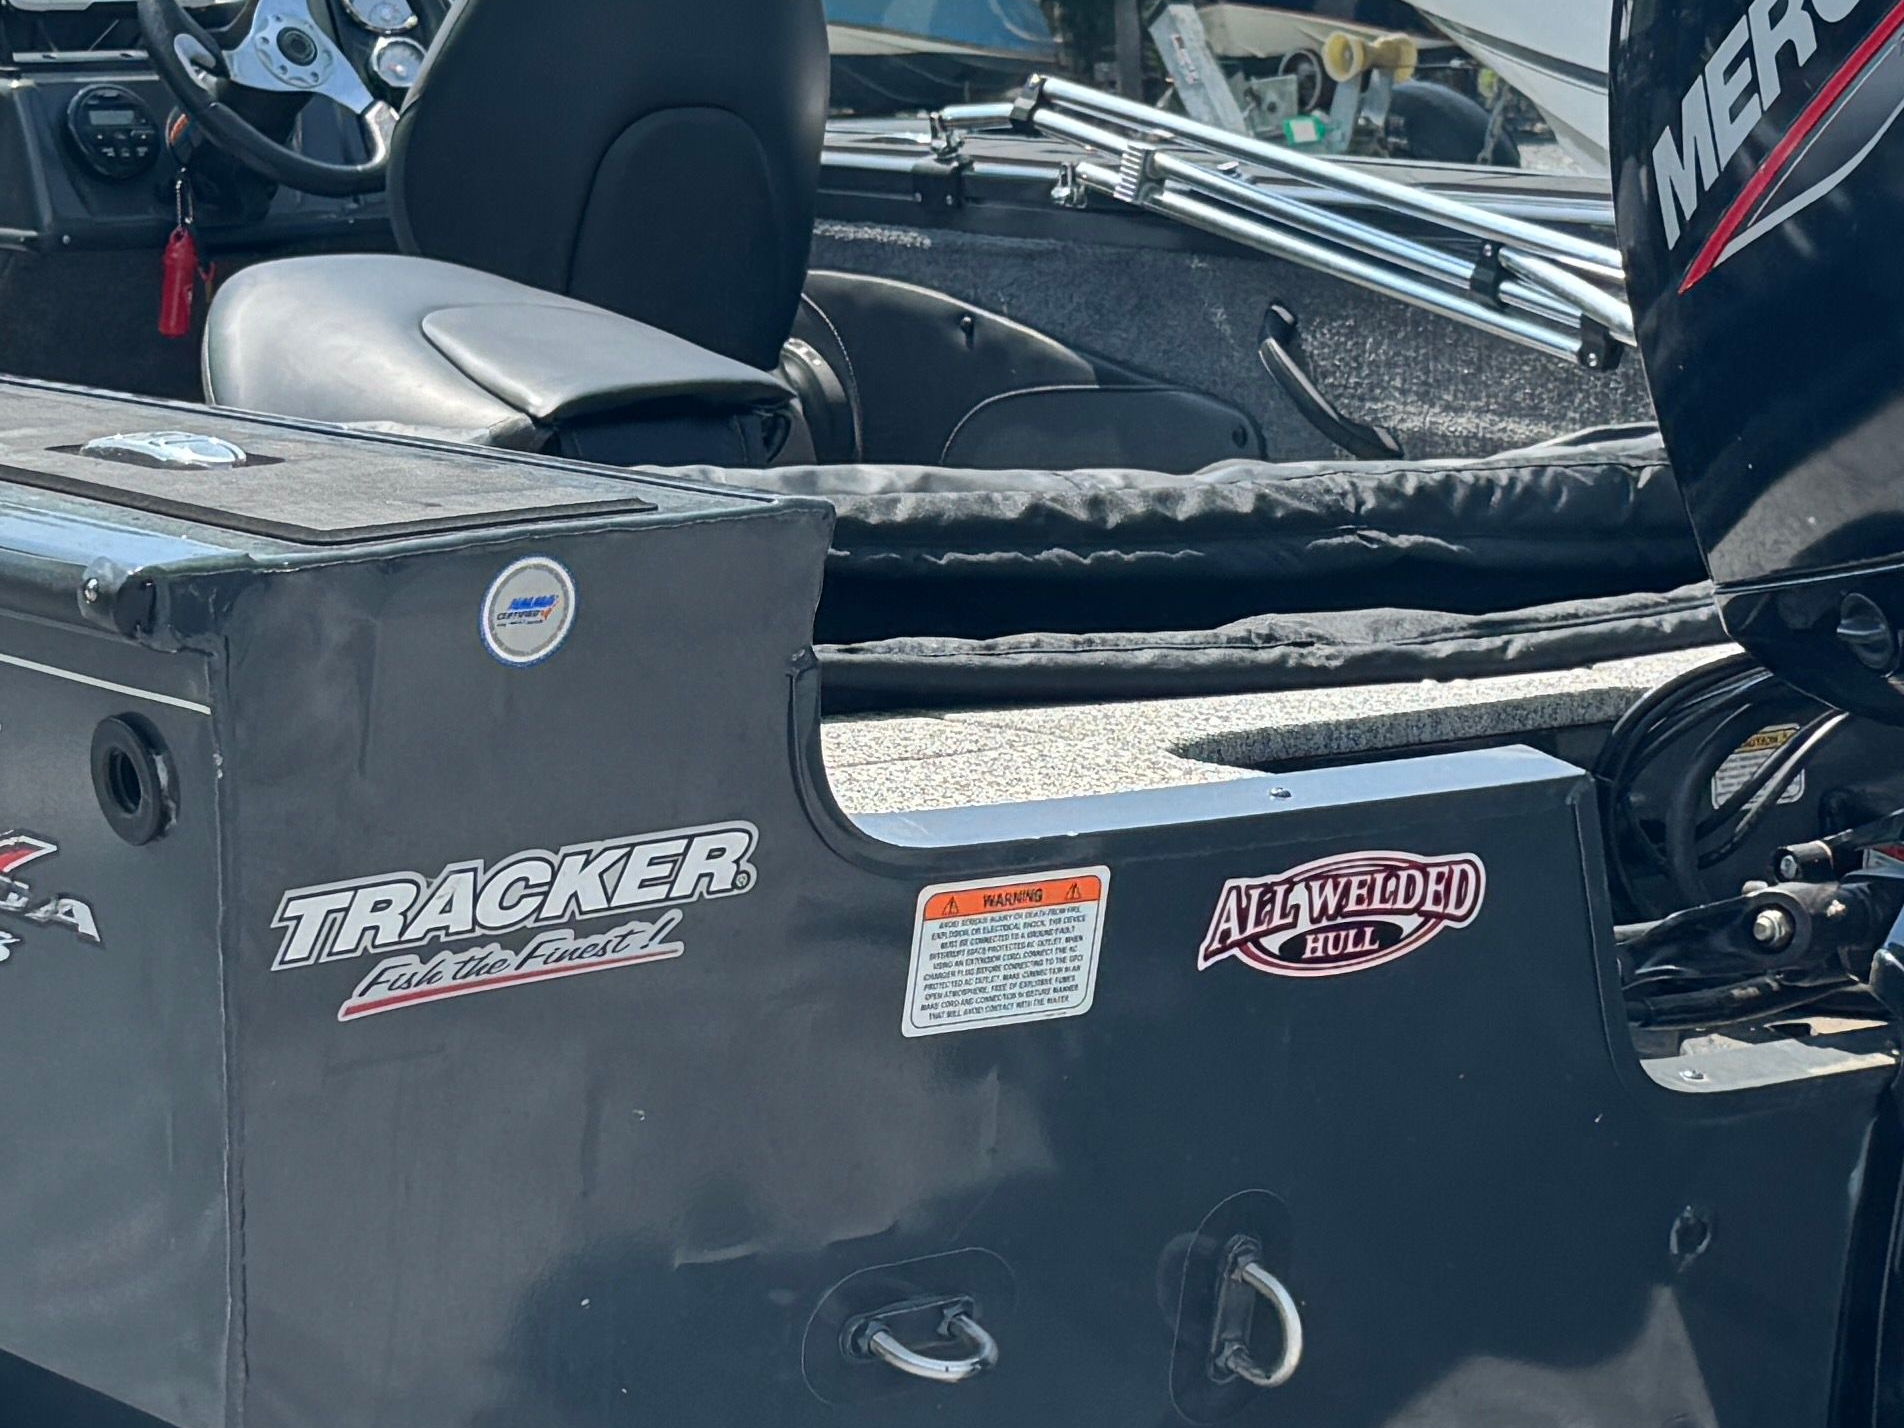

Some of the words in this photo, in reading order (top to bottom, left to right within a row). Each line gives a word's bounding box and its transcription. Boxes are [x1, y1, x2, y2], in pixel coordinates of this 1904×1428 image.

[276, 826, 753, 967] TRACKER
[983, 888, 1044, 909] WARNING
[1207, 880, 1300, 955] ALL
[1306, 863, 1478, 921] WELDED
[1301, 926, 1381, 960] HULL
[358, 960, 457, 998] Fish
[452, 949, 511, 980] the
